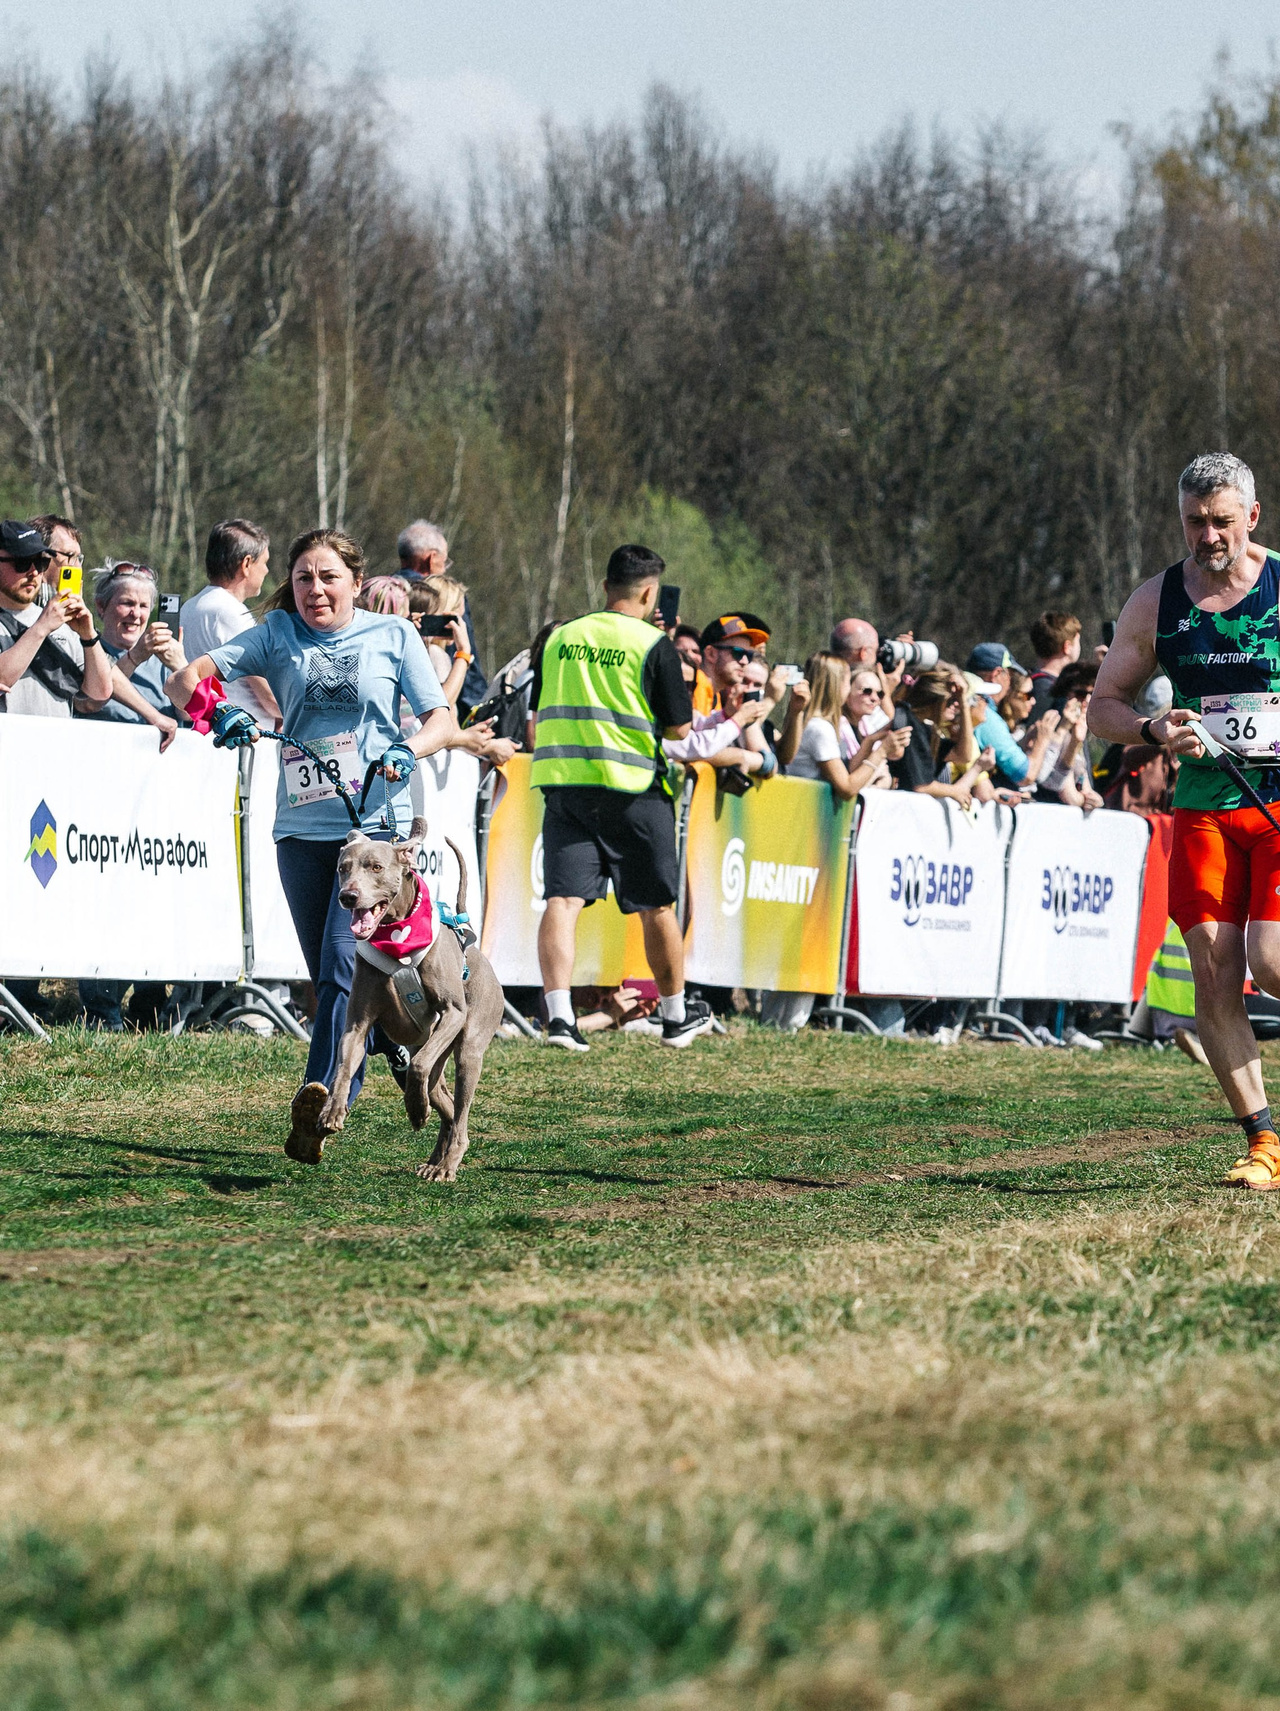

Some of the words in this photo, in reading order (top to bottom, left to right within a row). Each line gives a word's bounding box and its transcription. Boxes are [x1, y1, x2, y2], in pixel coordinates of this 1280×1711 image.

[303, 704, 360, 713] BELARUS
[1225, 716, 1257, 741] 36
[298, 758, 341, 788] 318
[747, 859, 820, 905] INSANITY
